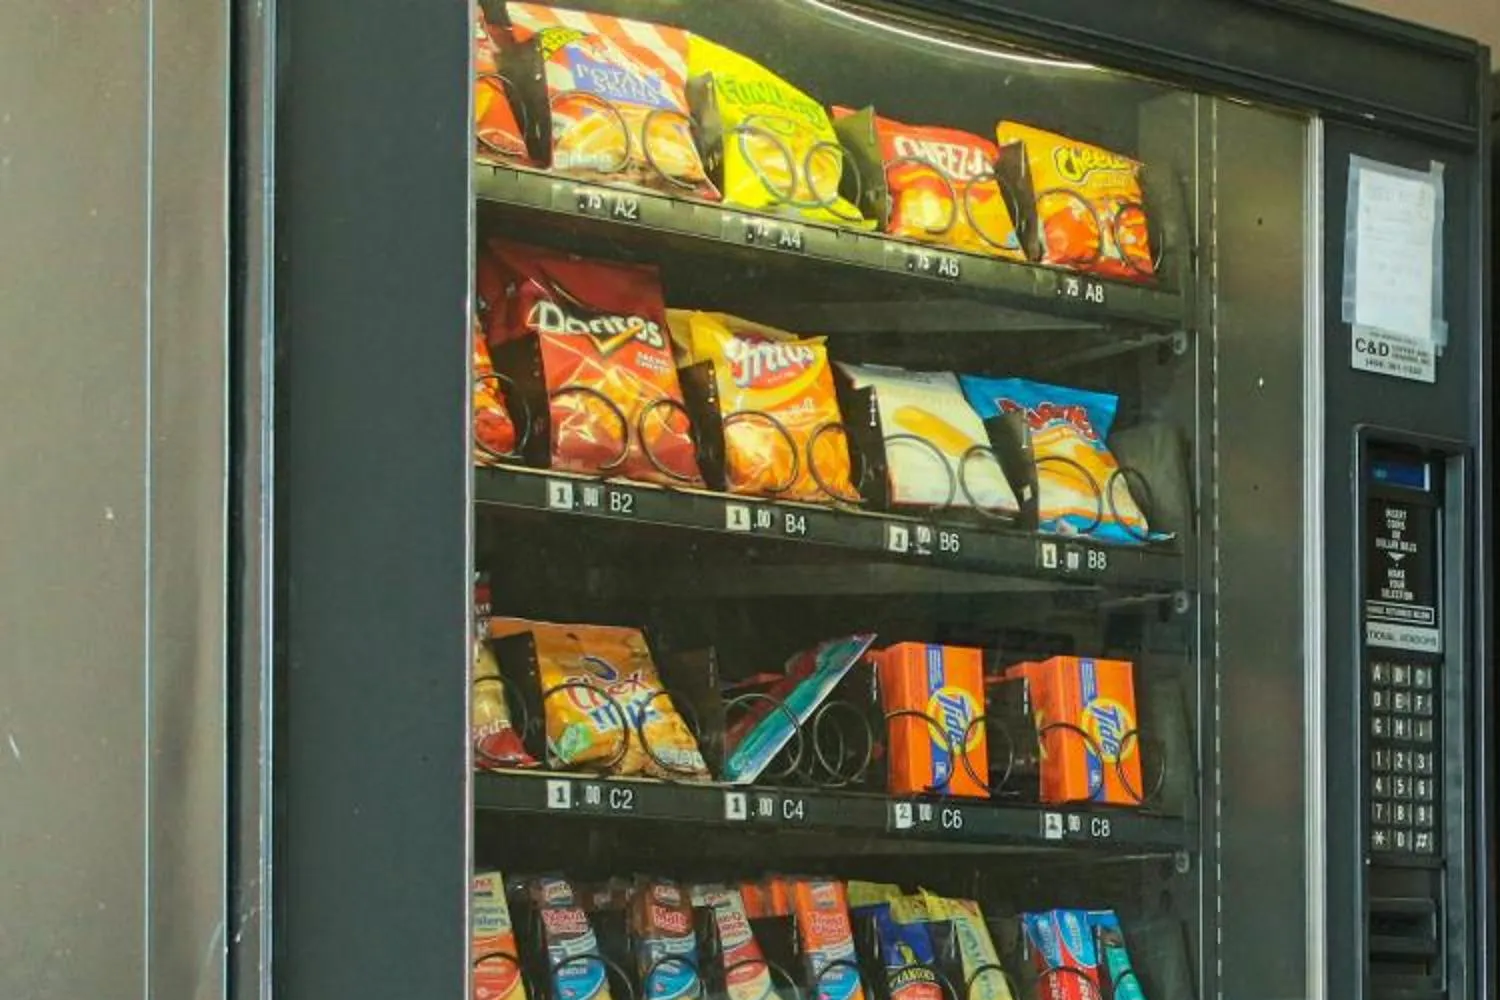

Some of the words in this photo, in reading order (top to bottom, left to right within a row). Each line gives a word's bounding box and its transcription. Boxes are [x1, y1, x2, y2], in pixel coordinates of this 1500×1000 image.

[613, 201, 638, 220] A2
[938, 260, 960, 277] A6
[1085, 283, 1105, 304] A8
[530, 300, 666, 349] Doritos
[1355, 337, 1389, 357] C&D
[610, 491, 634, 514] B2
[785, 512, 807, 535] B4
[939, 532, 960, 552] B6
[1087, 551, 1107, 570] B8
[936, 692, 967, 755] Tide
[1090, 705, 1123, 762] Tide
[610, 788, 633, 810] C2
[783, 799, 805, 820] C4
[941, 809, 963, 829] C6
[1091, 817, 1111, 837] C8
